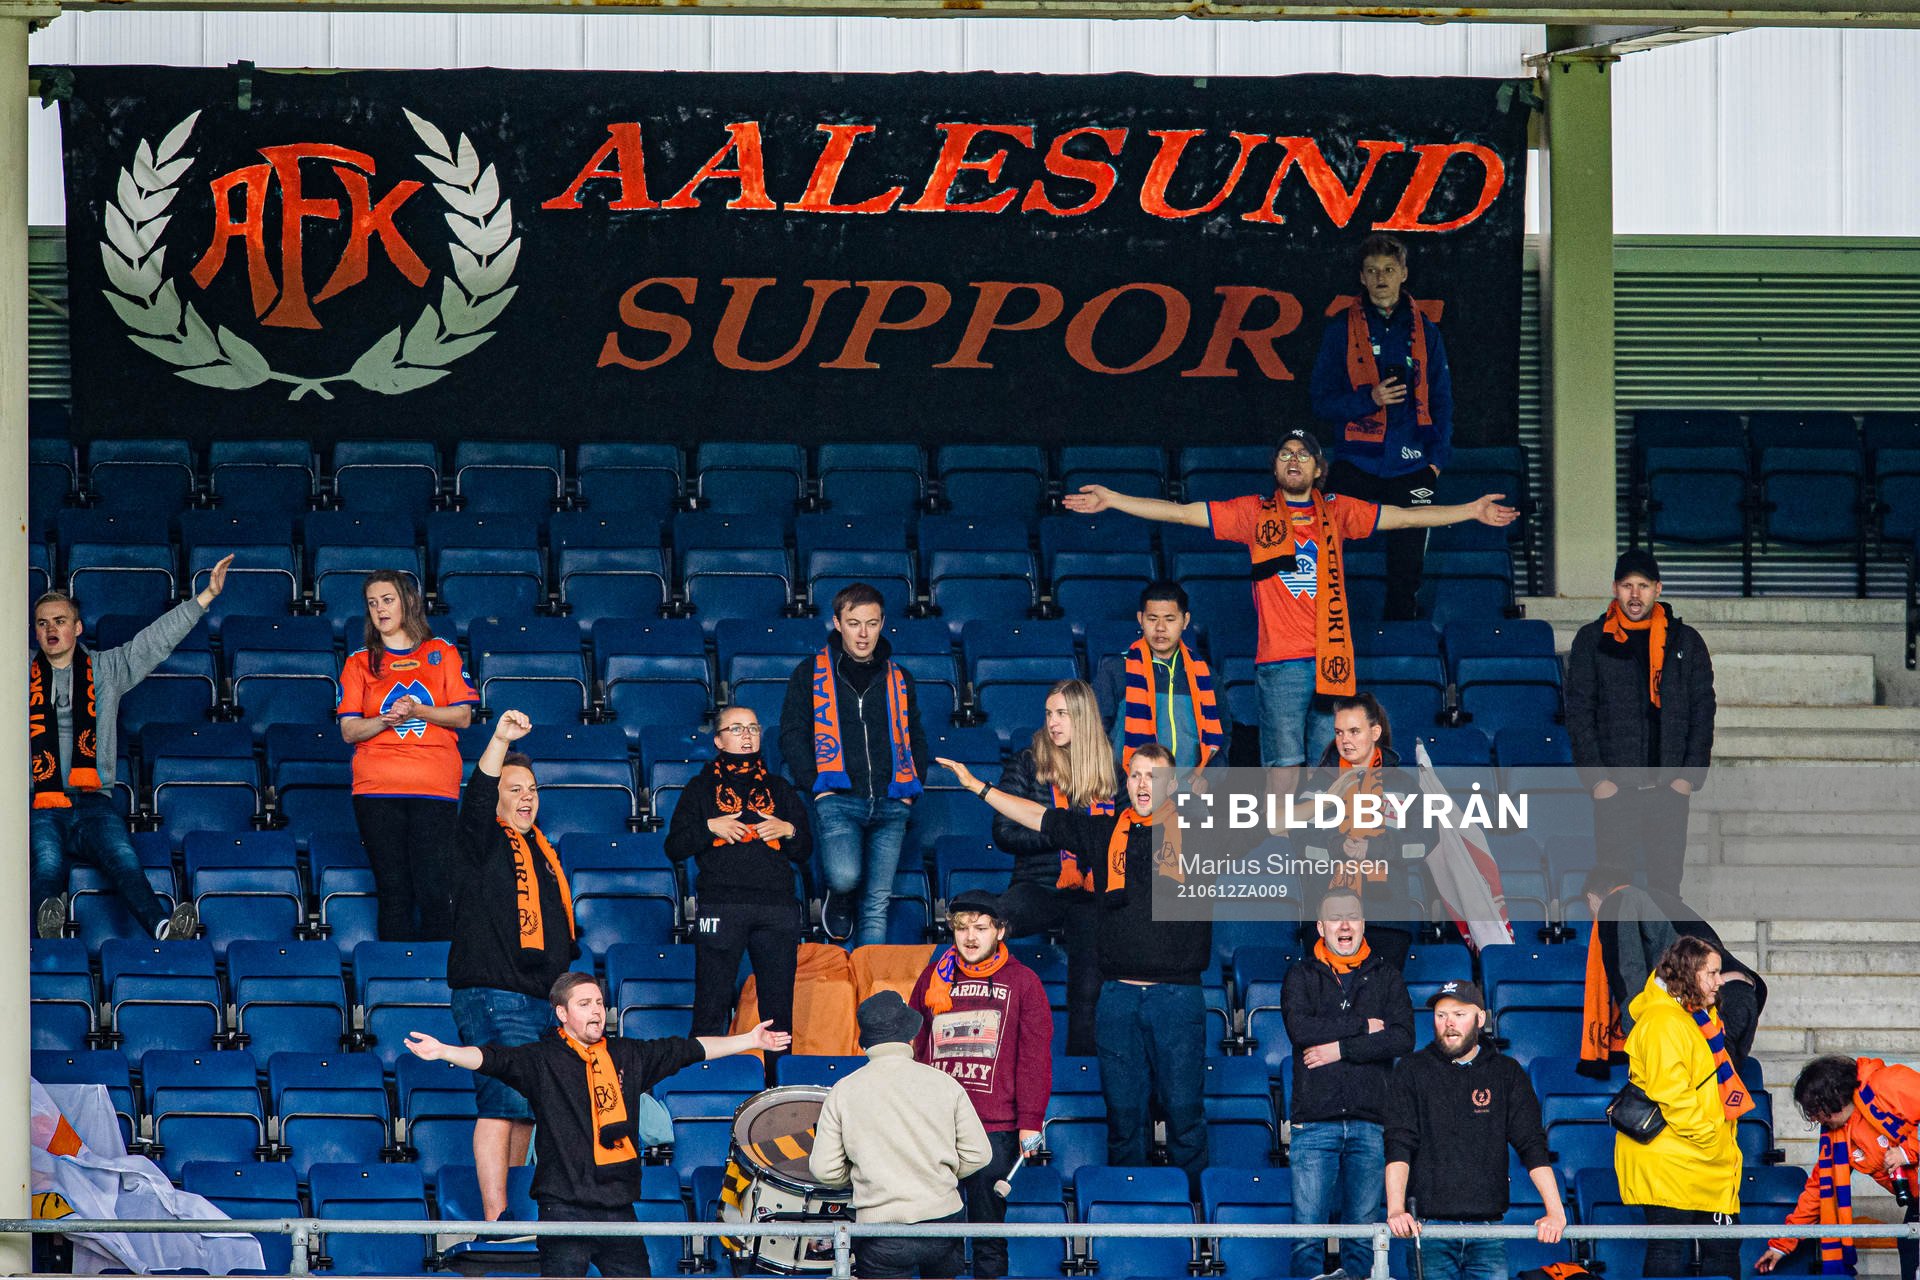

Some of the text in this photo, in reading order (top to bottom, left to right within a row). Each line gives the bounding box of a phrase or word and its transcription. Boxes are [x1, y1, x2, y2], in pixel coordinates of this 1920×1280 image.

[541, 121, 1505, 232] AALESUND
[190, 142, 431, 329] AFK
[700, 918, 720, 933] MT
